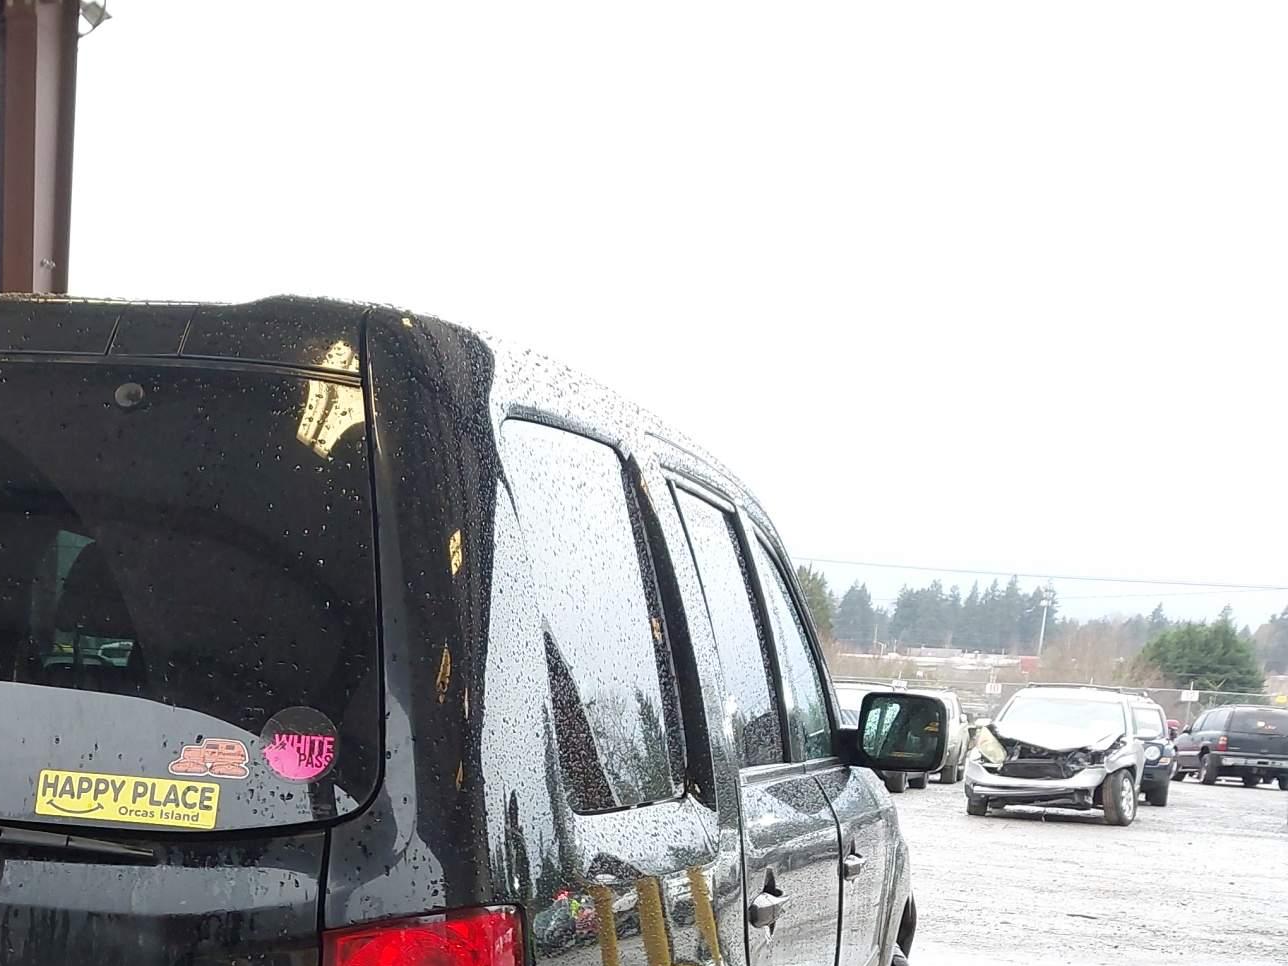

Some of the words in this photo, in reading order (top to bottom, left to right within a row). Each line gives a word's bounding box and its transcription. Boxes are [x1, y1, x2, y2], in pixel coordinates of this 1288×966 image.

[274, 733, 335, 757] WHITE
[298, 752, 334, 769] PASS
[41, 774, 126, 803] HAPPY
[131, 781, 216, 811] PLACE
[118, 806, 155, 818] Orcas
[159, 809, 200, 822] Island
